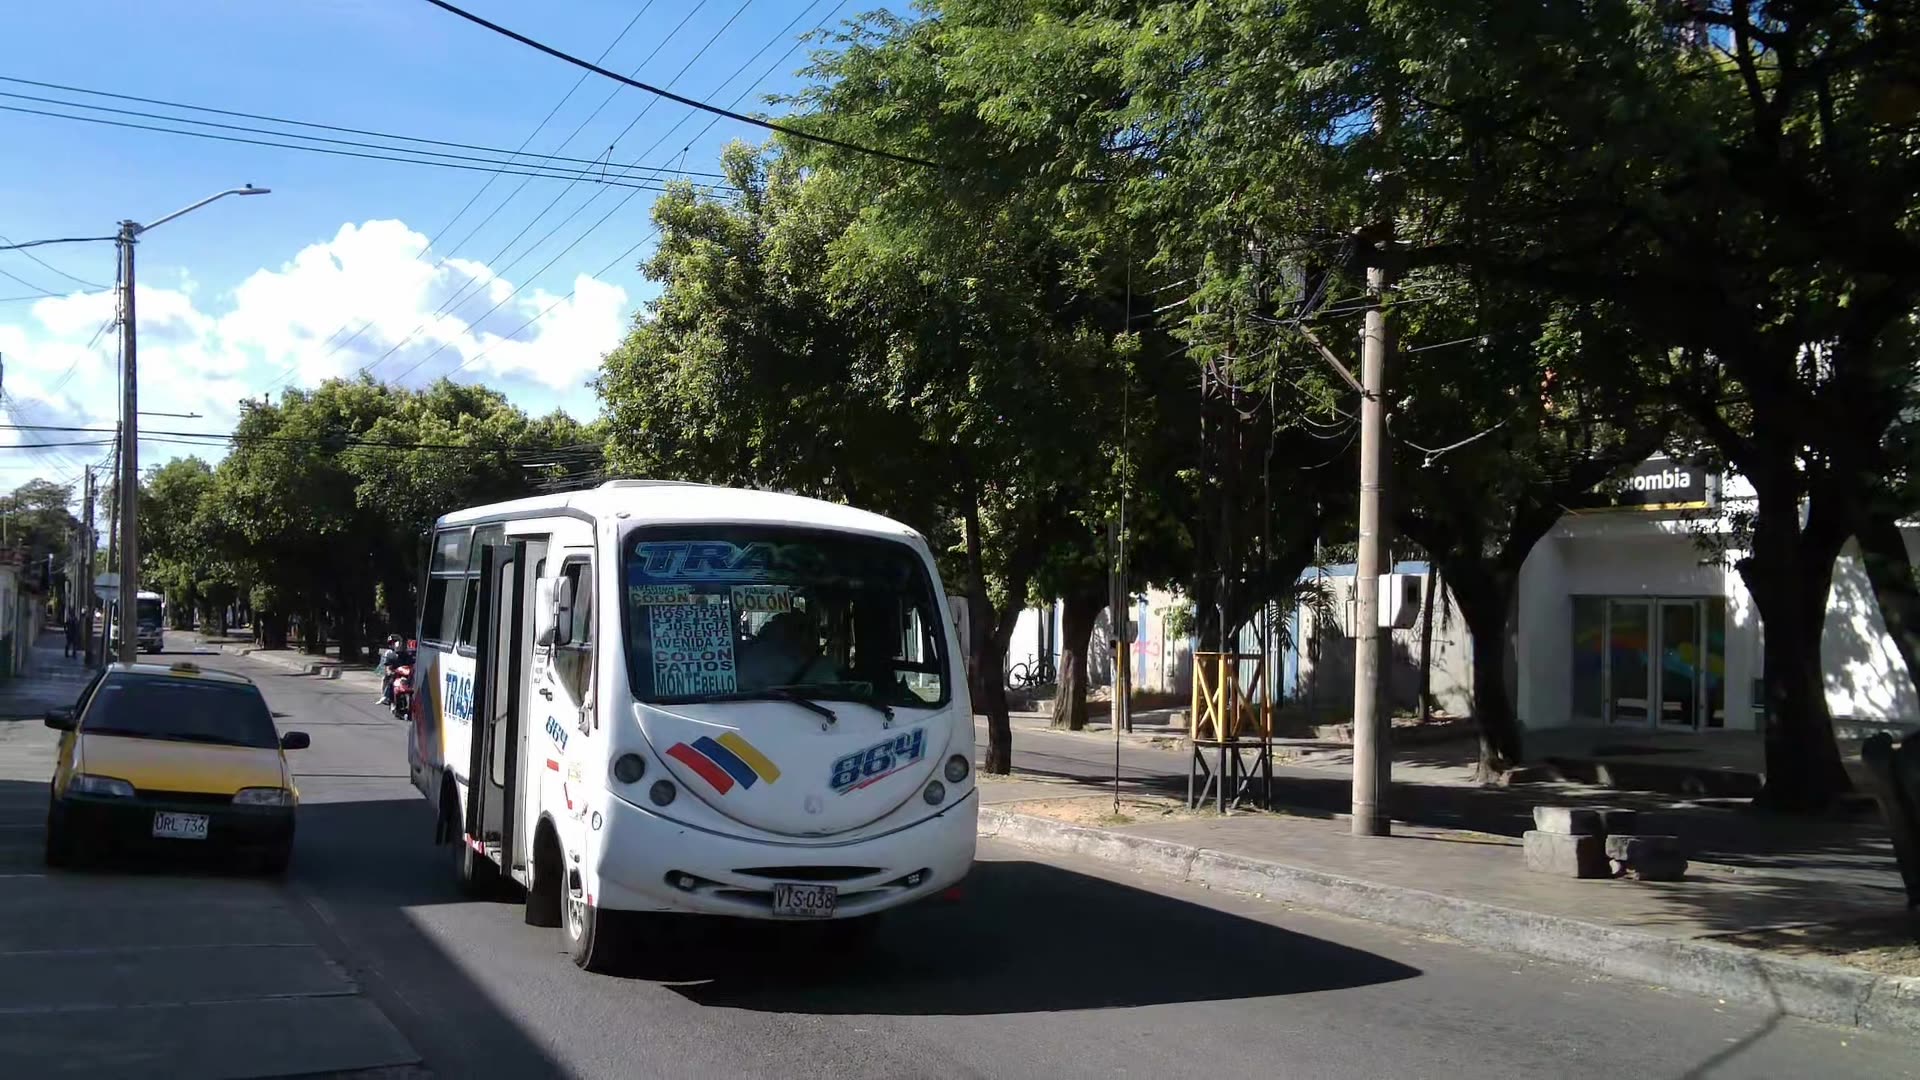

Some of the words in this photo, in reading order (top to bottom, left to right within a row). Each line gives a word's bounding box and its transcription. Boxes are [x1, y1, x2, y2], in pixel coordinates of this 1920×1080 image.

[631, 593, 688, 603] COLON
[733, 591, 790, 609] COLON
[652, 608, 728, 619] HOSPITAL
[666, 621, 729, 631] JUSTICIA
[676, 629, 729, 638] FUENTE
[655, 639, 713, 648] AVENIDA
[655, 649, 732, 662] COLON
[656, 661, 733, 674] PATIOS
[655, 673, 735, 696] MONTEBELLO
[546, 716, 568, 750] 864
[830, 727, 927, 790] 864
[156, 815, 178, 832] URL
[183, 817, 206, 833] 736
